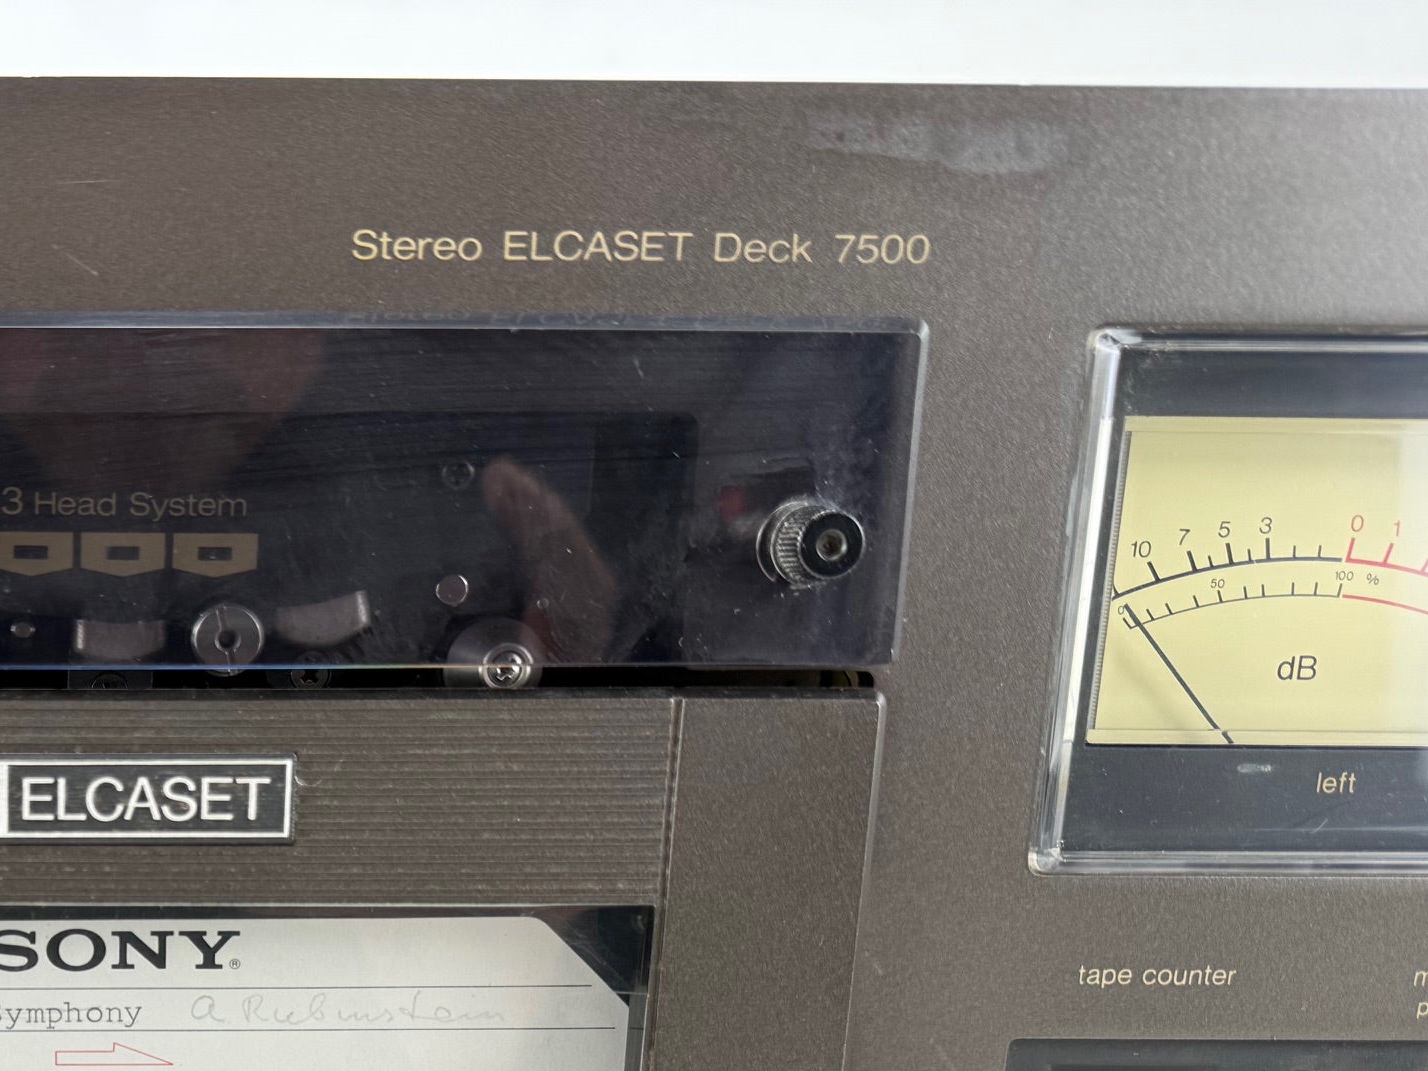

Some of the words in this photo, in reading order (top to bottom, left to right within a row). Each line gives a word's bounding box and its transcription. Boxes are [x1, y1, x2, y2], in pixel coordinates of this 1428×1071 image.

[351, 229, 483, 262] Stereo
[503, 230, 694, 263] ELCASET
[713, 232, 813, 265] Deck
[834, 233, 931, 266] 7500
[1, 486, 23, 516] 3
[34, 491, 117, 517] Head
[129, 491, 248, 522] System
[1130, 540, 1152, 559] 10
[1178, 528, 1191, 546] 7
[1217, 520, 1231, 539] 5
[1258, 516, 1273, 535] 3
[1350, 514, 1365, 533] 0
[1393, 519, 1402, 537] 1
[1210, 578, 1226, 590] 50
[1335, 570, 1355, 582] 100
[1276, 654, 1318, 682] dB
[1315, 771, 1357, 794] left
[21, 776, 272, 823] ELCASET
[1078, 964, 1133, 989] tape
[1141, 965, 1237, 986] counter
